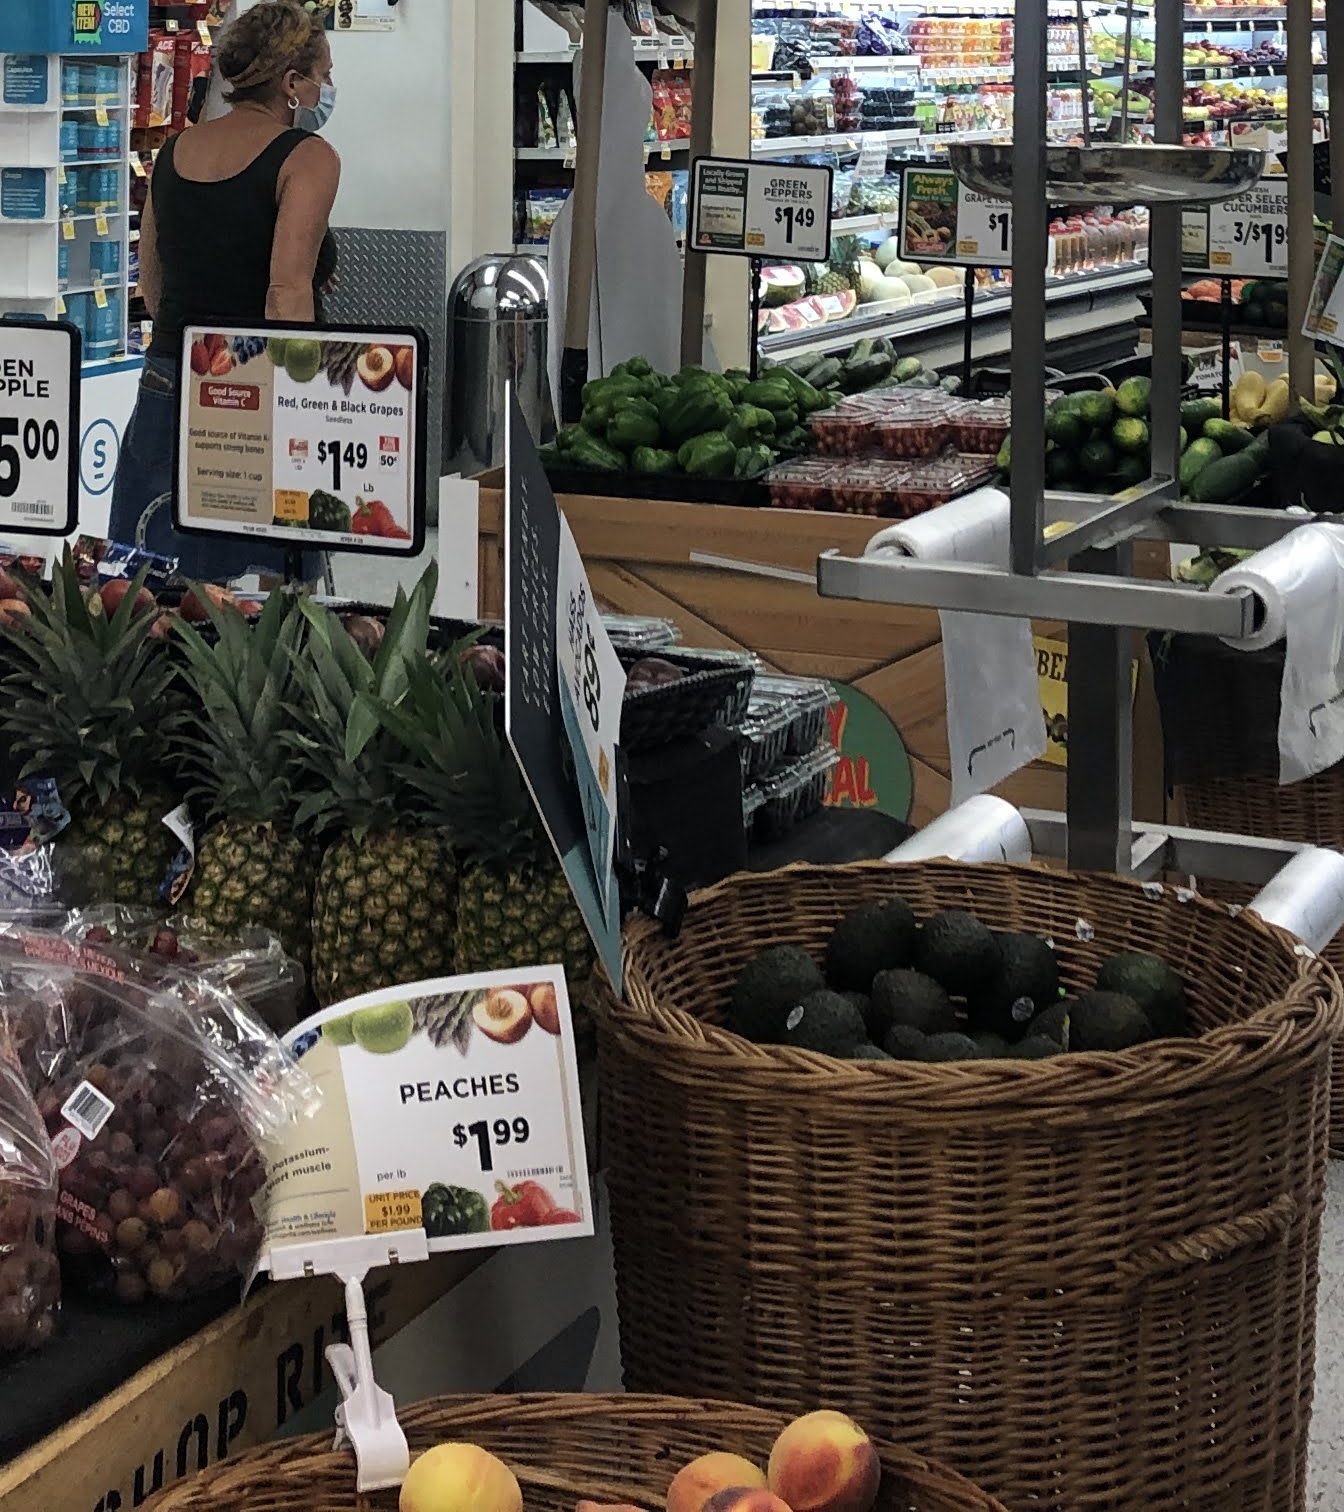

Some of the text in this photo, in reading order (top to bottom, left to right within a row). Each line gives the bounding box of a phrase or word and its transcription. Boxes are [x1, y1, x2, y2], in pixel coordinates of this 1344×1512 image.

[77, 4, 96, 17] NEW
[104, 2, 135, 17] Select
[76, 17, 96, 30] ITEM
[108, 19, 131, 33] CBD
[156, 39, 174, 51] ACE
[770, 179, 808, 190] GREEN
[913, 174, 954, 186] Always
[764, 188, 813, 199] PEPPERS
[1257, 194, 1288, 204] SELEC
[208, 387, 251, 399] Good Source
[277, 396, 299, 410] Red,
[301, 399, 329, 411] Green
[341, 400, 367, 414] Black
[369, 403, 404, 417] Grapes
[325, 415, 354, 425] Seedless
[197, 466, 222, 478] Serving
[363, 483, 375, 494] Lb
[399, 1072, 520, 1104] PEACHES
[292, 1162, 332, 1179] muscle
[376, 1168, 406, 1183] per lb
[368, 1189, 420, 1202] UNIT PRICE
[59, 1190, 97, 1220] GRAPES
[381, 1204, 411, 1217] $1.99
[369, 1216, 423, 1229] PER POUND
